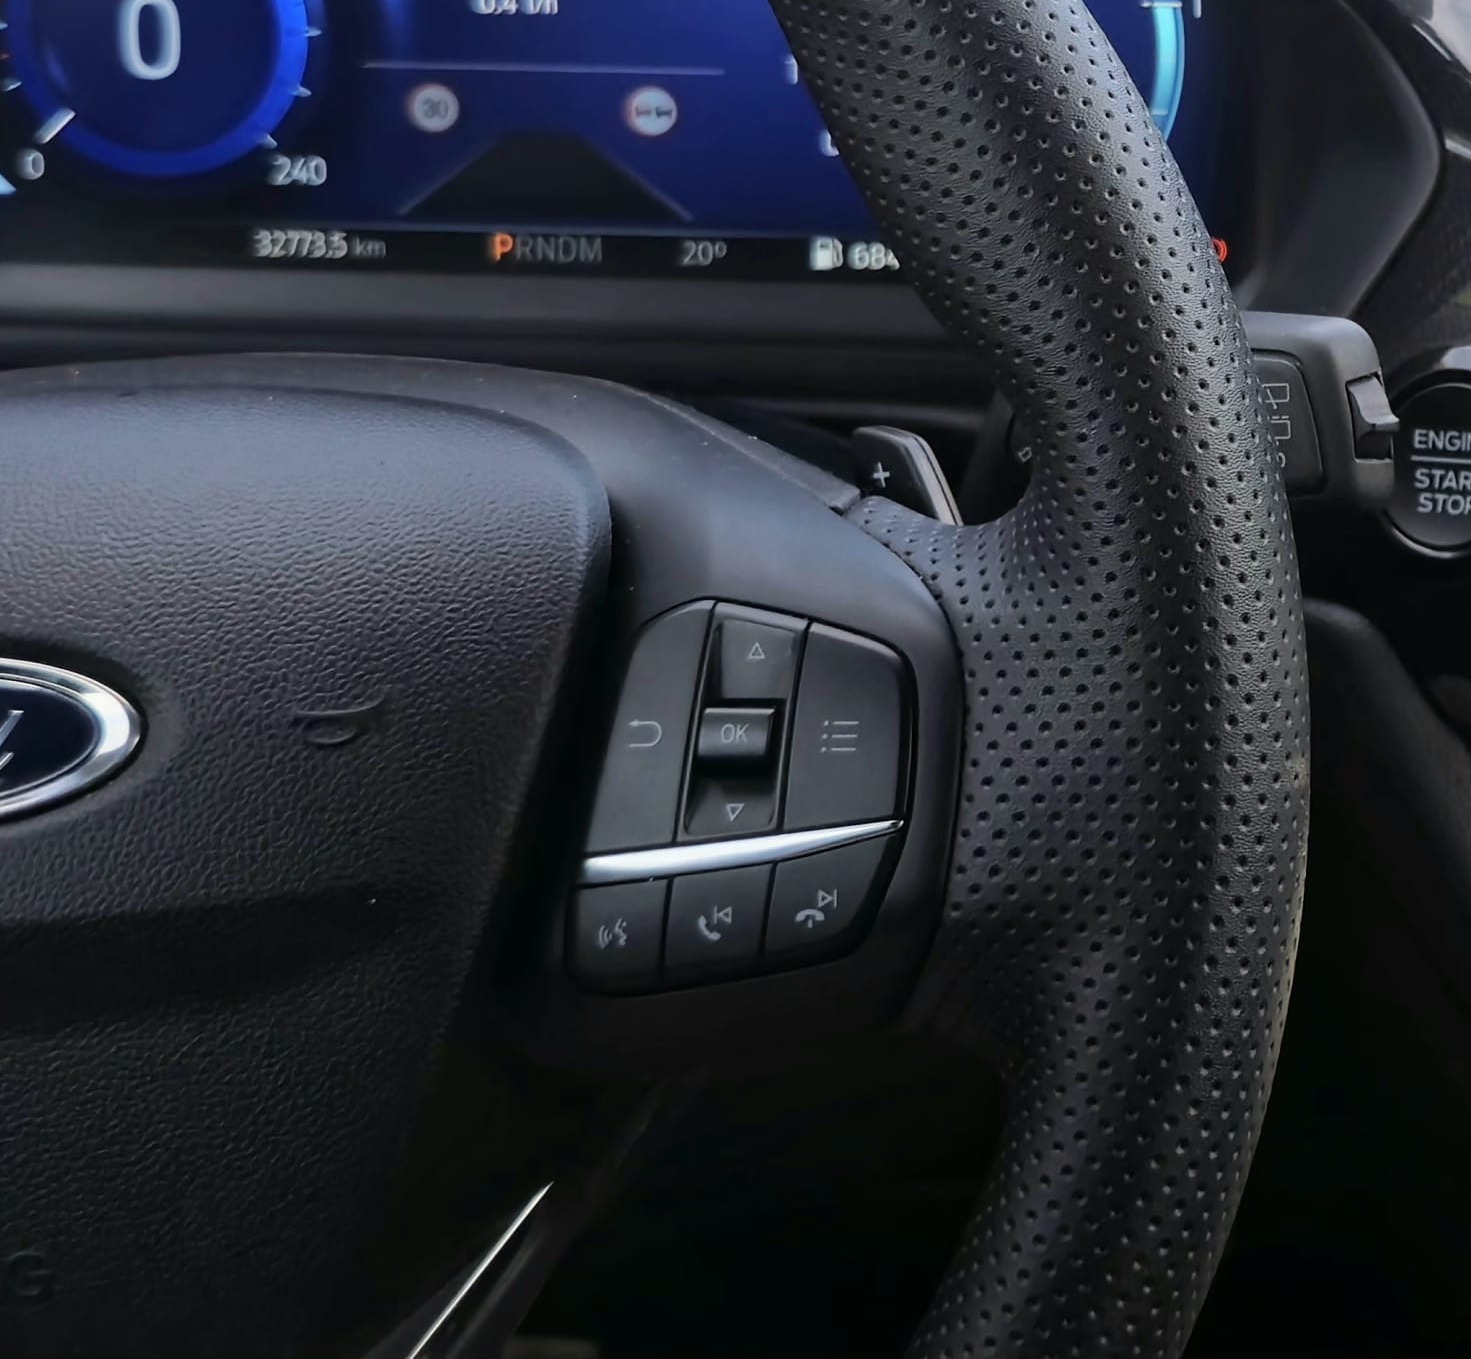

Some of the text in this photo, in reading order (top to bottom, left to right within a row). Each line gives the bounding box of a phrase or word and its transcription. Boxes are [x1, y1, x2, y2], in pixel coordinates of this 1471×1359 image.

[17, 148, 45, 180] 0
[269, 155, 327, 186] 240
[351, 238, 386, 257] km
[720, 723, 749, 743] OK
